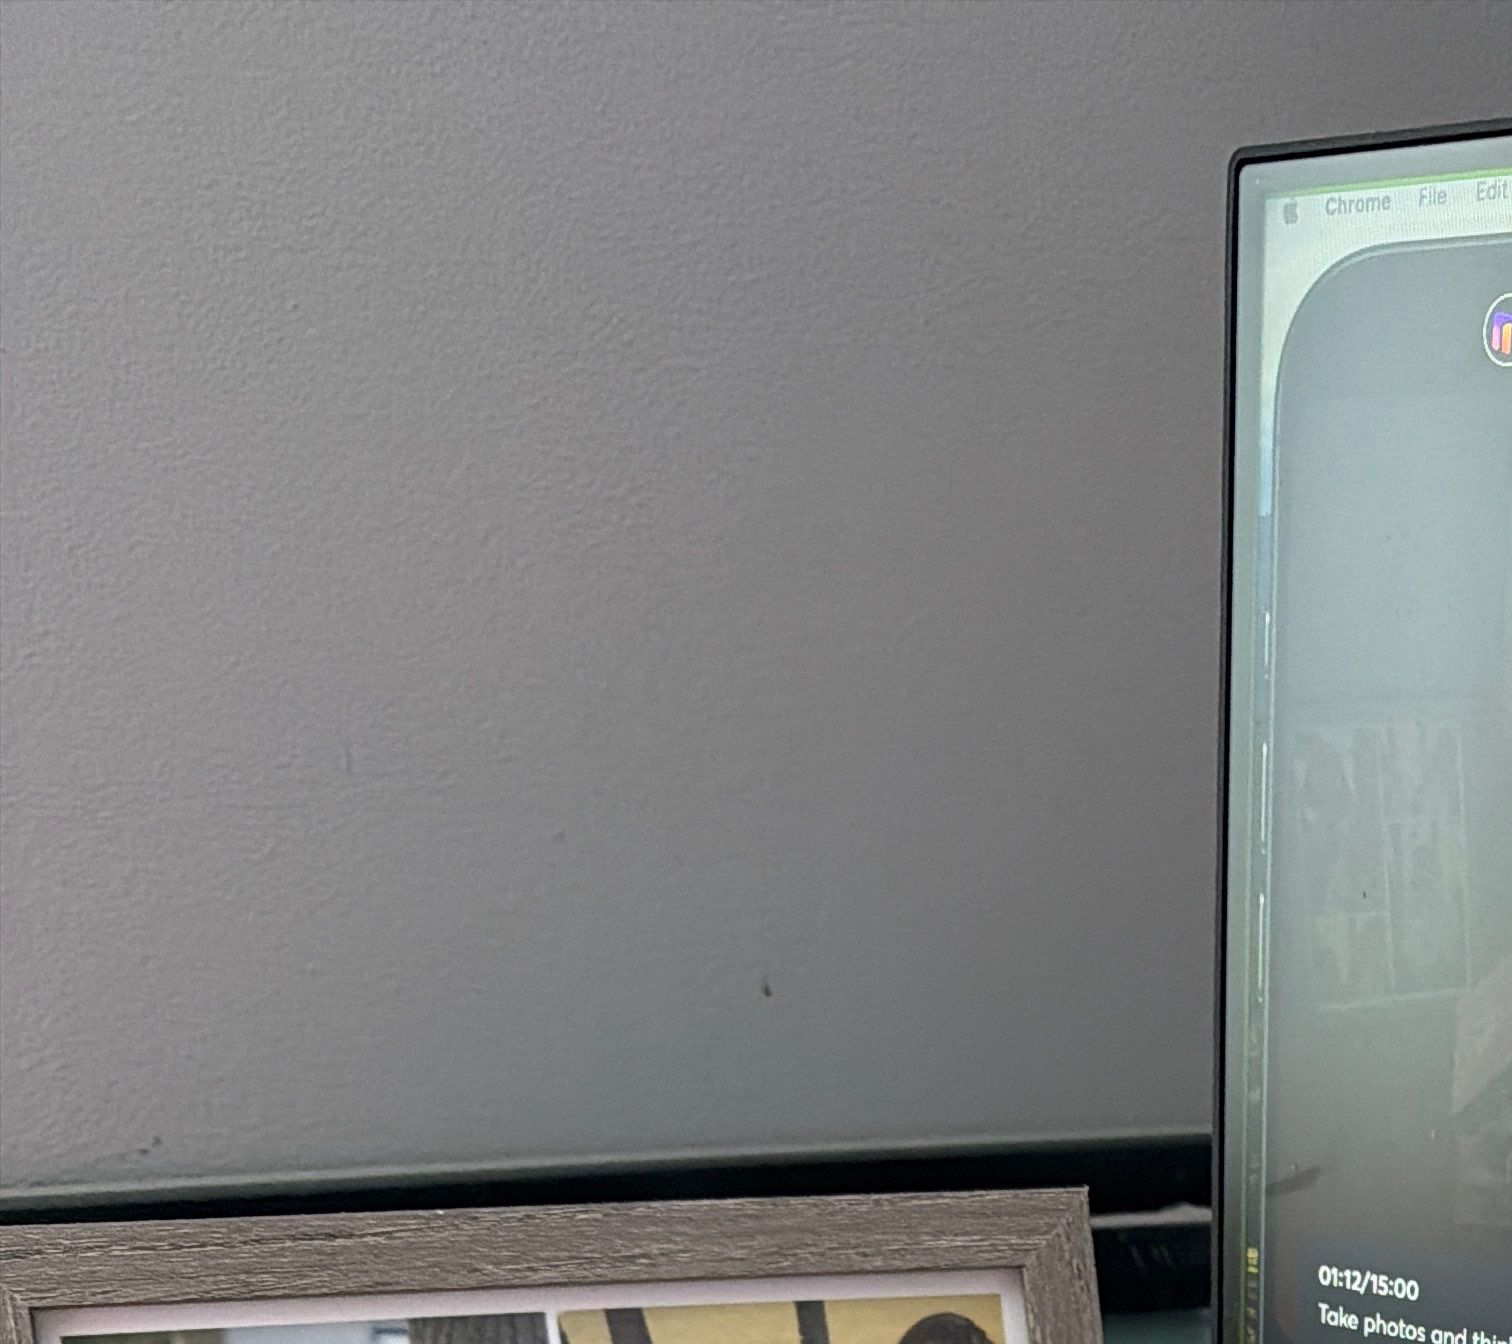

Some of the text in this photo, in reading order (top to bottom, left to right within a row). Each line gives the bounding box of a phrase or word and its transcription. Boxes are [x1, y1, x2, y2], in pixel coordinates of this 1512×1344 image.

[1418, 186, 1447, 206] File
[1476, 180, 1508, 201] Edit
[1325, 192, 1391, 216] Chrome
[1318, 1264, 1420, 1302] 01:12/15:00
[1318, 1302, 1359, 1331] Take
[1363, 1313, 1426, 1343] photos
